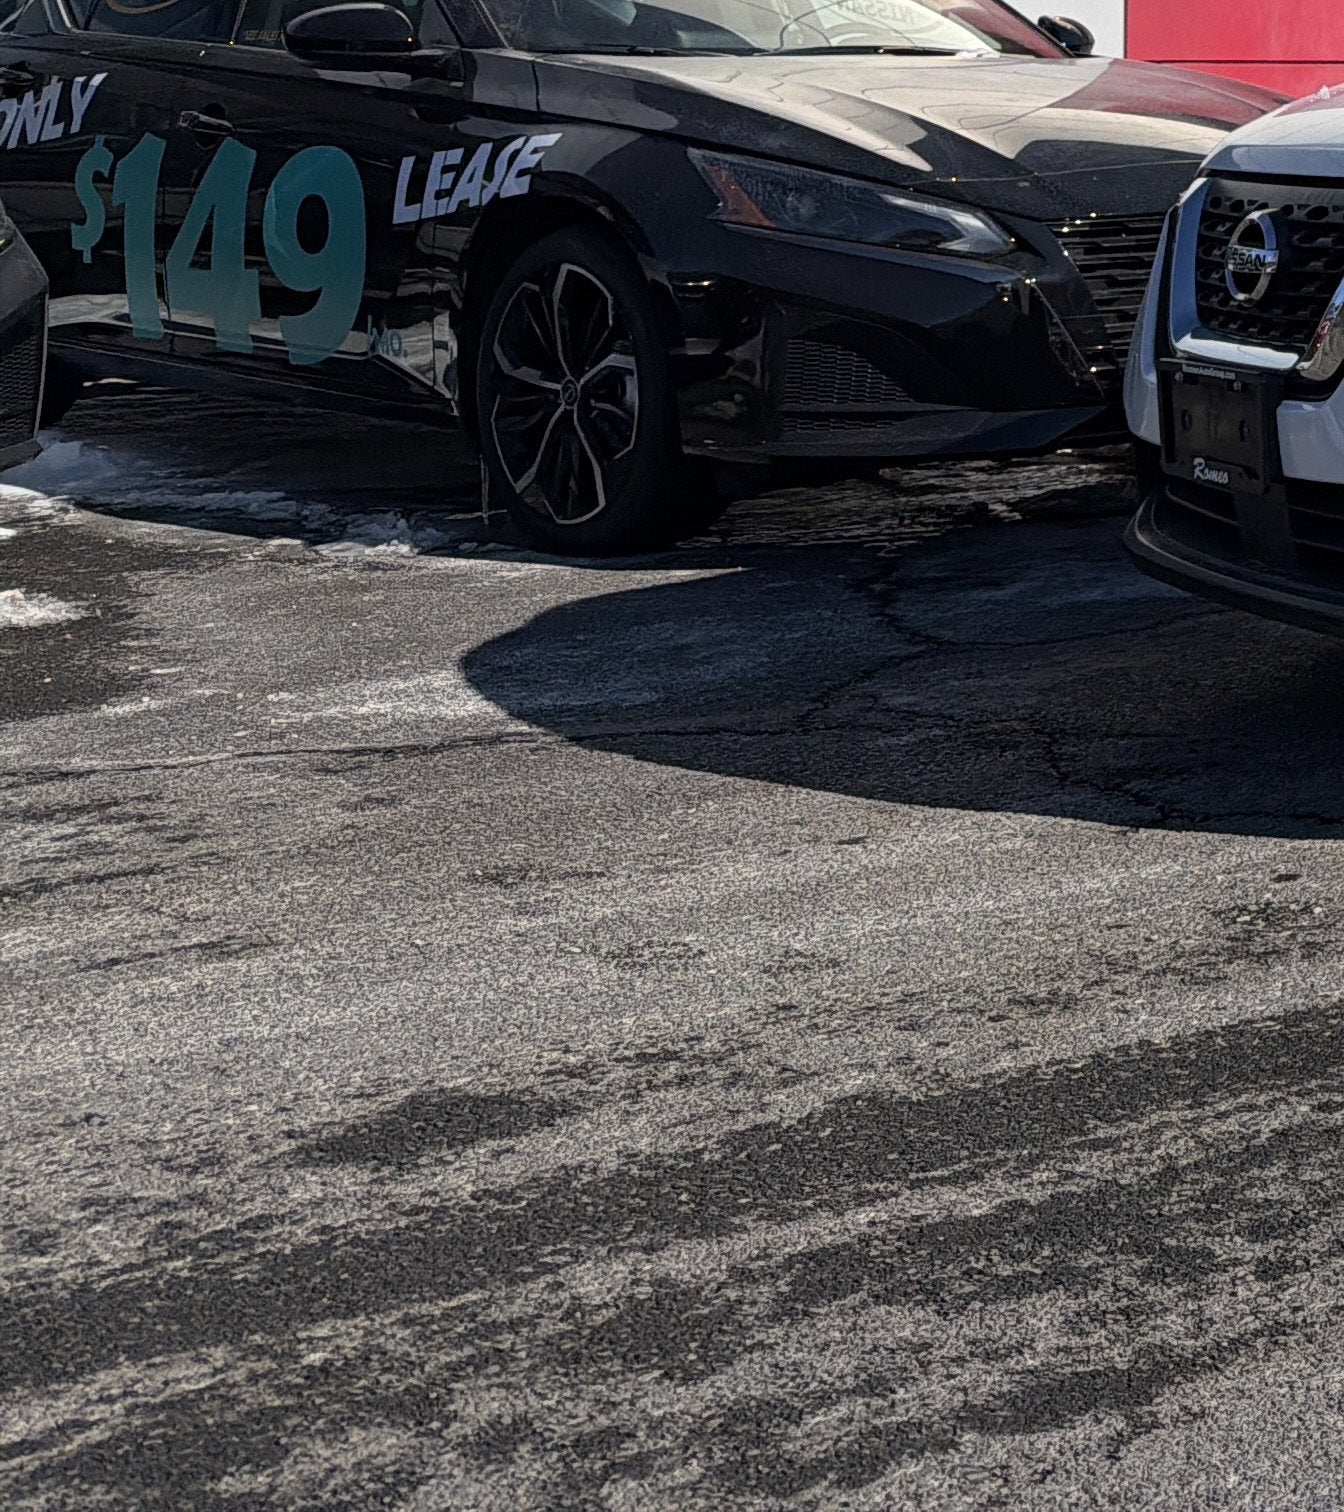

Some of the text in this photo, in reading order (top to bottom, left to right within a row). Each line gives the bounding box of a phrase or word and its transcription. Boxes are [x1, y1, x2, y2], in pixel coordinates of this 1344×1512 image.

[392, 132, 563, 225] LEASE
[70, 131, 367, 366] $149
[1193, 457, 1229, 484] Romeo
